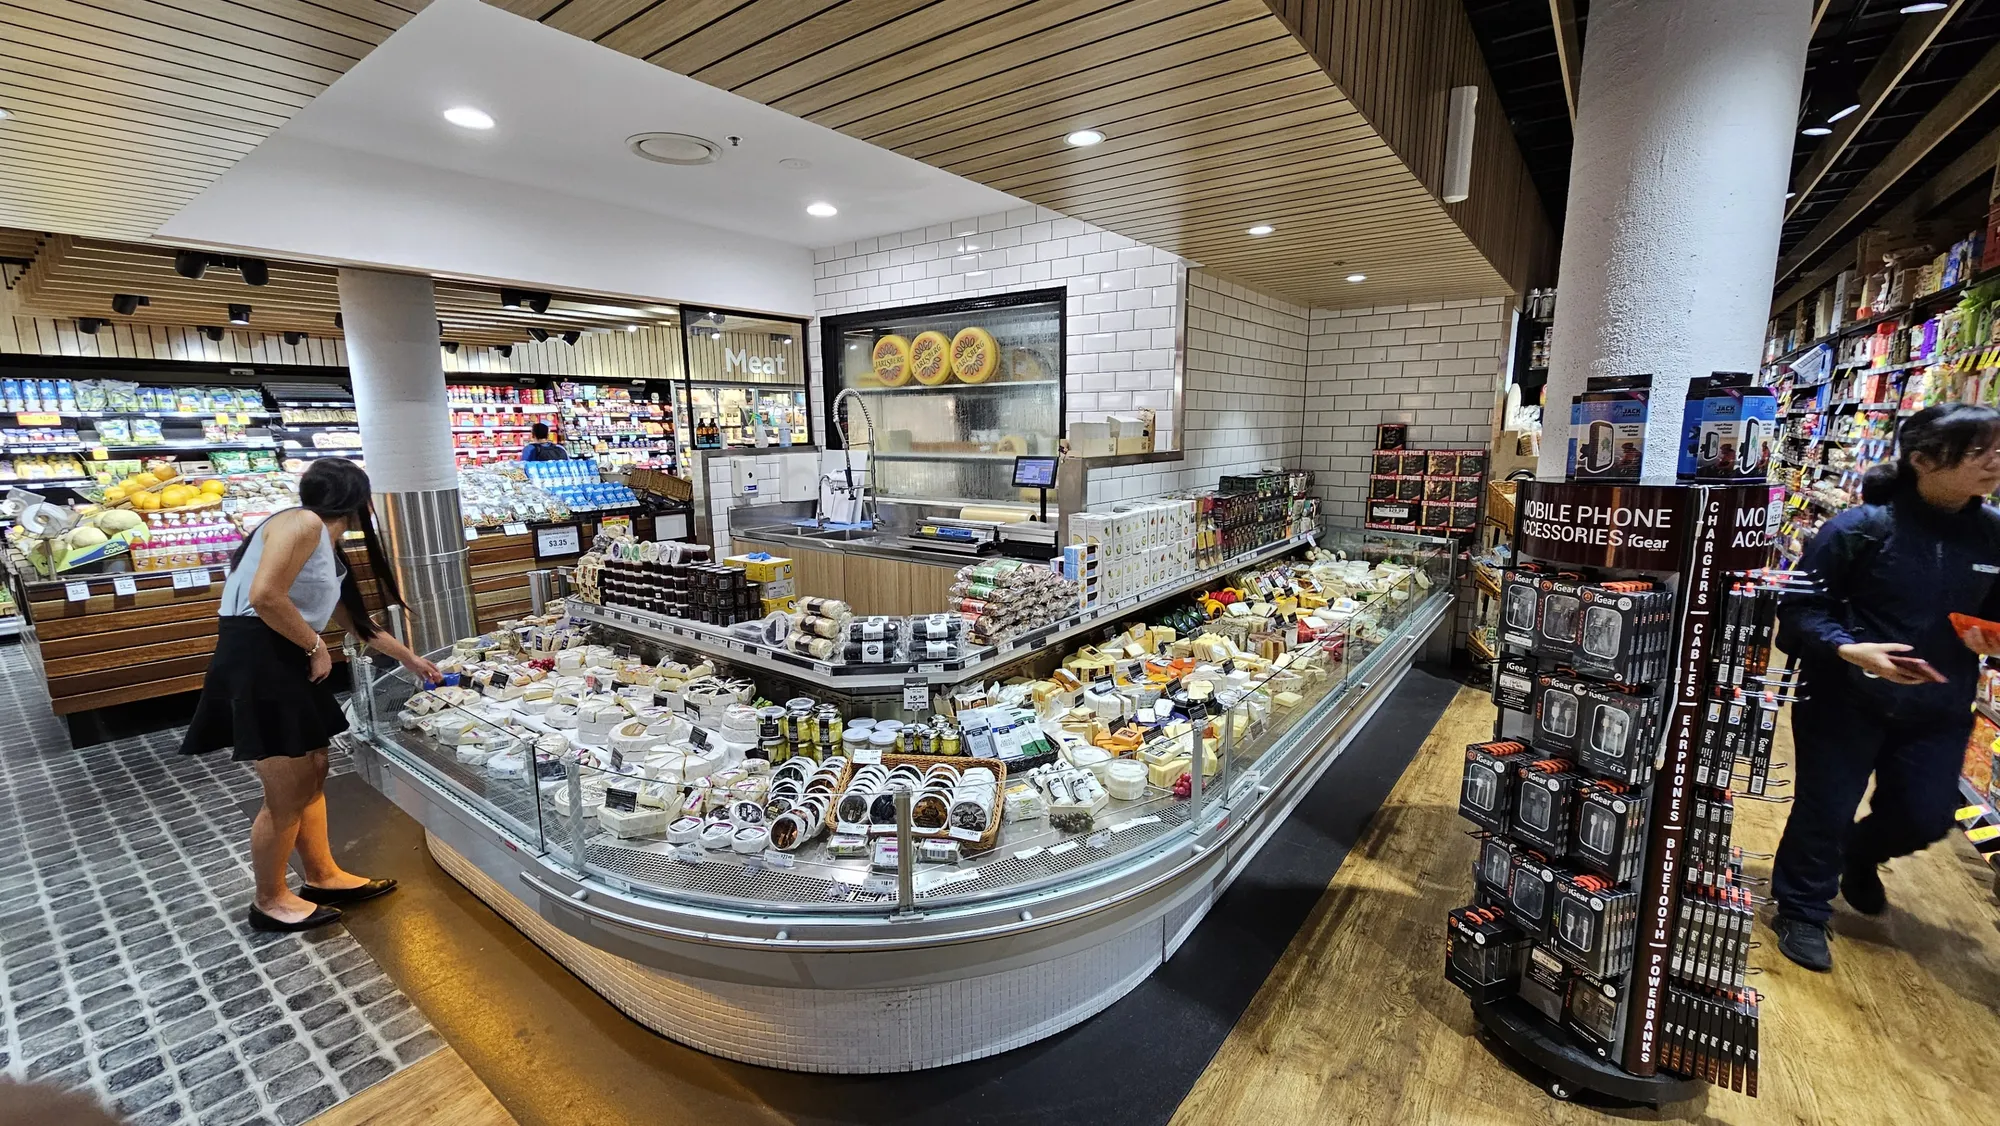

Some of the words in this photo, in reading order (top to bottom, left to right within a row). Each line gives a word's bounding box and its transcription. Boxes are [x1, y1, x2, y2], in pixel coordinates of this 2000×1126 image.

[725, 347, 787, 375] Meat
[873, 355, 905, 372] JARLSBERG
[914, 343, 942, 374] JARLSBERG
[956, 340, 985, 373] JARLSBERG
[1524, 500, 1572, 523] MOBILE
[1577, 505, 1673, 528] PHONE
[1523, 519, 1624, 546] ACCESSORIES
[1628, 534, 1670, 549] iGear
[548, 539, 567, 548] $3.35
[1698, 501, 1720, 605] CHARGERS
[1514, 573, 1532, 584] iGear
[1553, 583, 1576, 594] iGear
[1594, 593, 1616, 606] iGear
[1724, 624, 1736, 640] iGear
[1739, 626, 1749, 642] iGear
[1506, 662, 1527, 673] iGear
[1686, 623, 1704, 697] CABLES
[1551, 678, 1572, 691] iGear
[1705, 729, 1715, 744] iGear
[1725, 732, 1736, 747] iGear
[1758, 737, 1769, 753] iGear
[1476, 753, 1494, 767] iGear
[1670, 715, 1692, 821] EARPHONES
[1528, 772, 1547, 785] iGear
[1590, 792, 1612, 806] iGear
[1568, 888, 1589, 903] iGear
[1654, 838, 1676, 940] BLUETOOTH
[1458, 922, 1474, 937] iGear
[1581, 972, 1602, 987] iGear
[1640, 954, 1662, 1063] POWERBANKS
